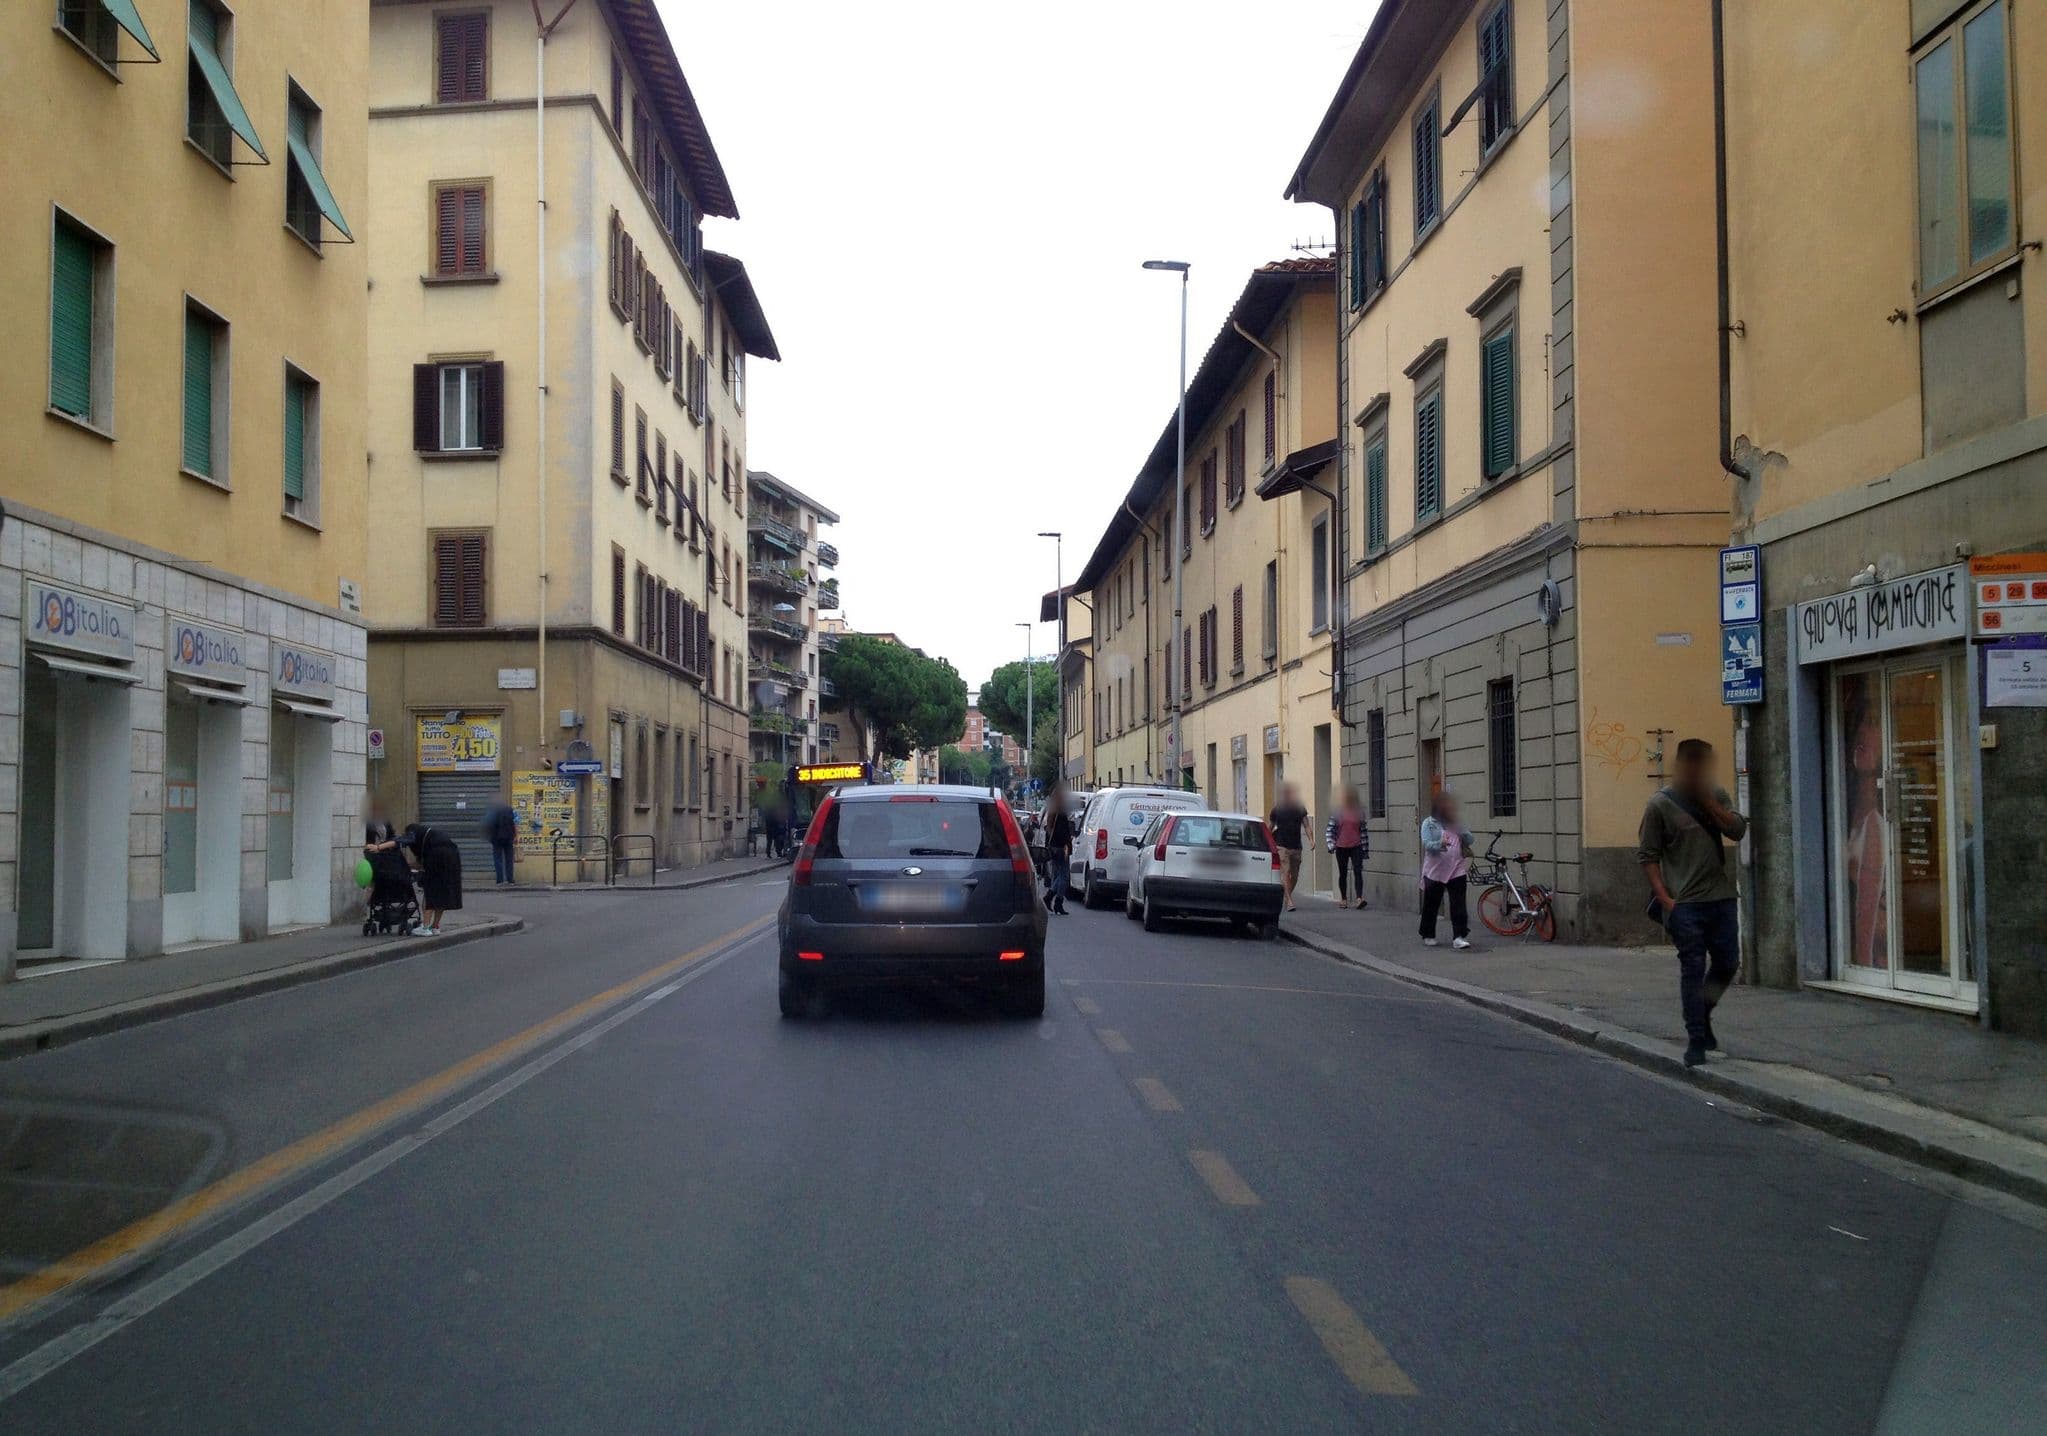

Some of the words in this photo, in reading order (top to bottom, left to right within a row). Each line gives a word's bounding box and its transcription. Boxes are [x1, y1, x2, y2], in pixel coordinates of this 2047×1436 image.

[1988, 588, 1996, 599] 5
[2008, 586, 2023, 597] 29
[36, 590, 121, 639] JOBitalia
[1803, 595, 1857, 650] NUOVA
[1866, 572, 1957, 640] IMMAGINE
[1985, 615, 1999, 626] 56
[174, 627, 239, 666] JOBitalia
[2022, 661, 2031, 673] 5
[1726, 688, 1758, 698] FERMATA
[421, 731, 451, 739] TUTTO
[547, 779, 571, 788] TUTTO
